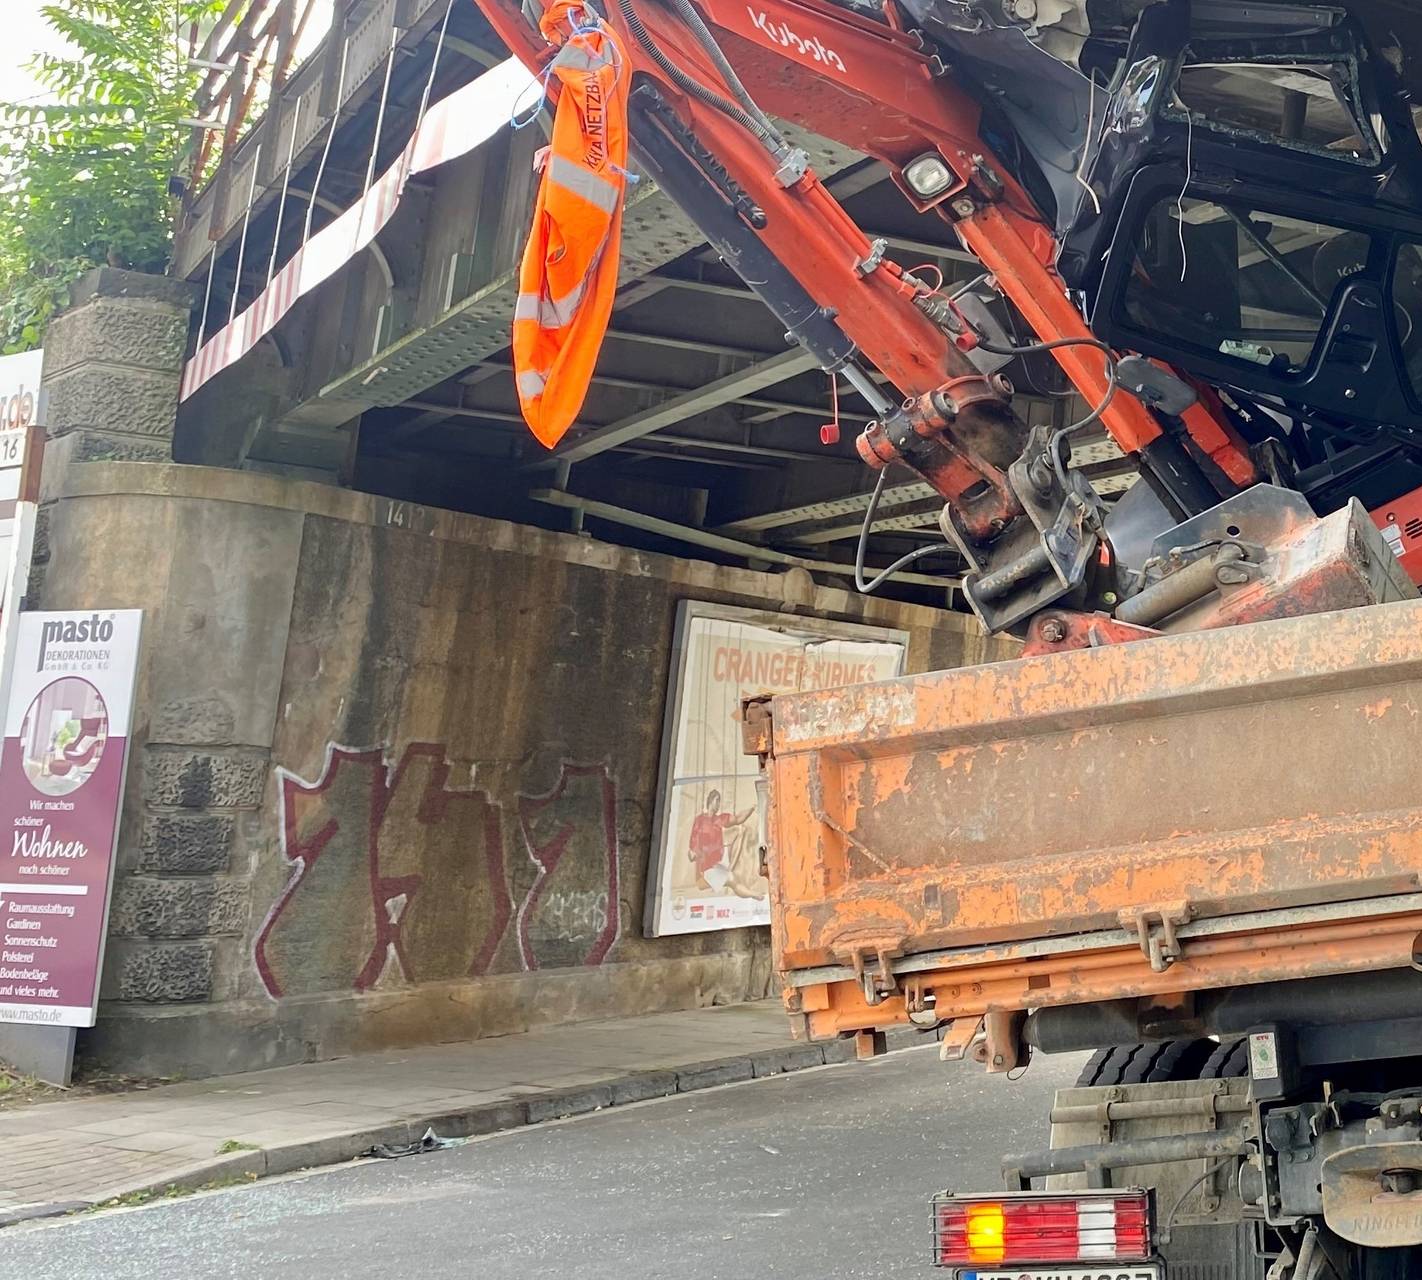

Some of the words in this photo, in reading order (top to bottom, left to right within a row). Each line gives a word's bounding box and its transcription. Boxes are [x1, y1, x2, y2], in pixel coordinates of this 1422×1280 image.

[746, 5, 847, 73] Kubota
[37, 614, 114, 672] masto
[46, 650, 111, 661] DEKORATIONEN
[30, 799, 43, 811] Wir
[44, 800, 75, 811] machen
[14, 816, 44, 827] schöner
[11, 824, 88, 858] Wohnen
[6, 918, 41, 930] Gardinen
[4, 934, 58, 948] Sonnenschutz
